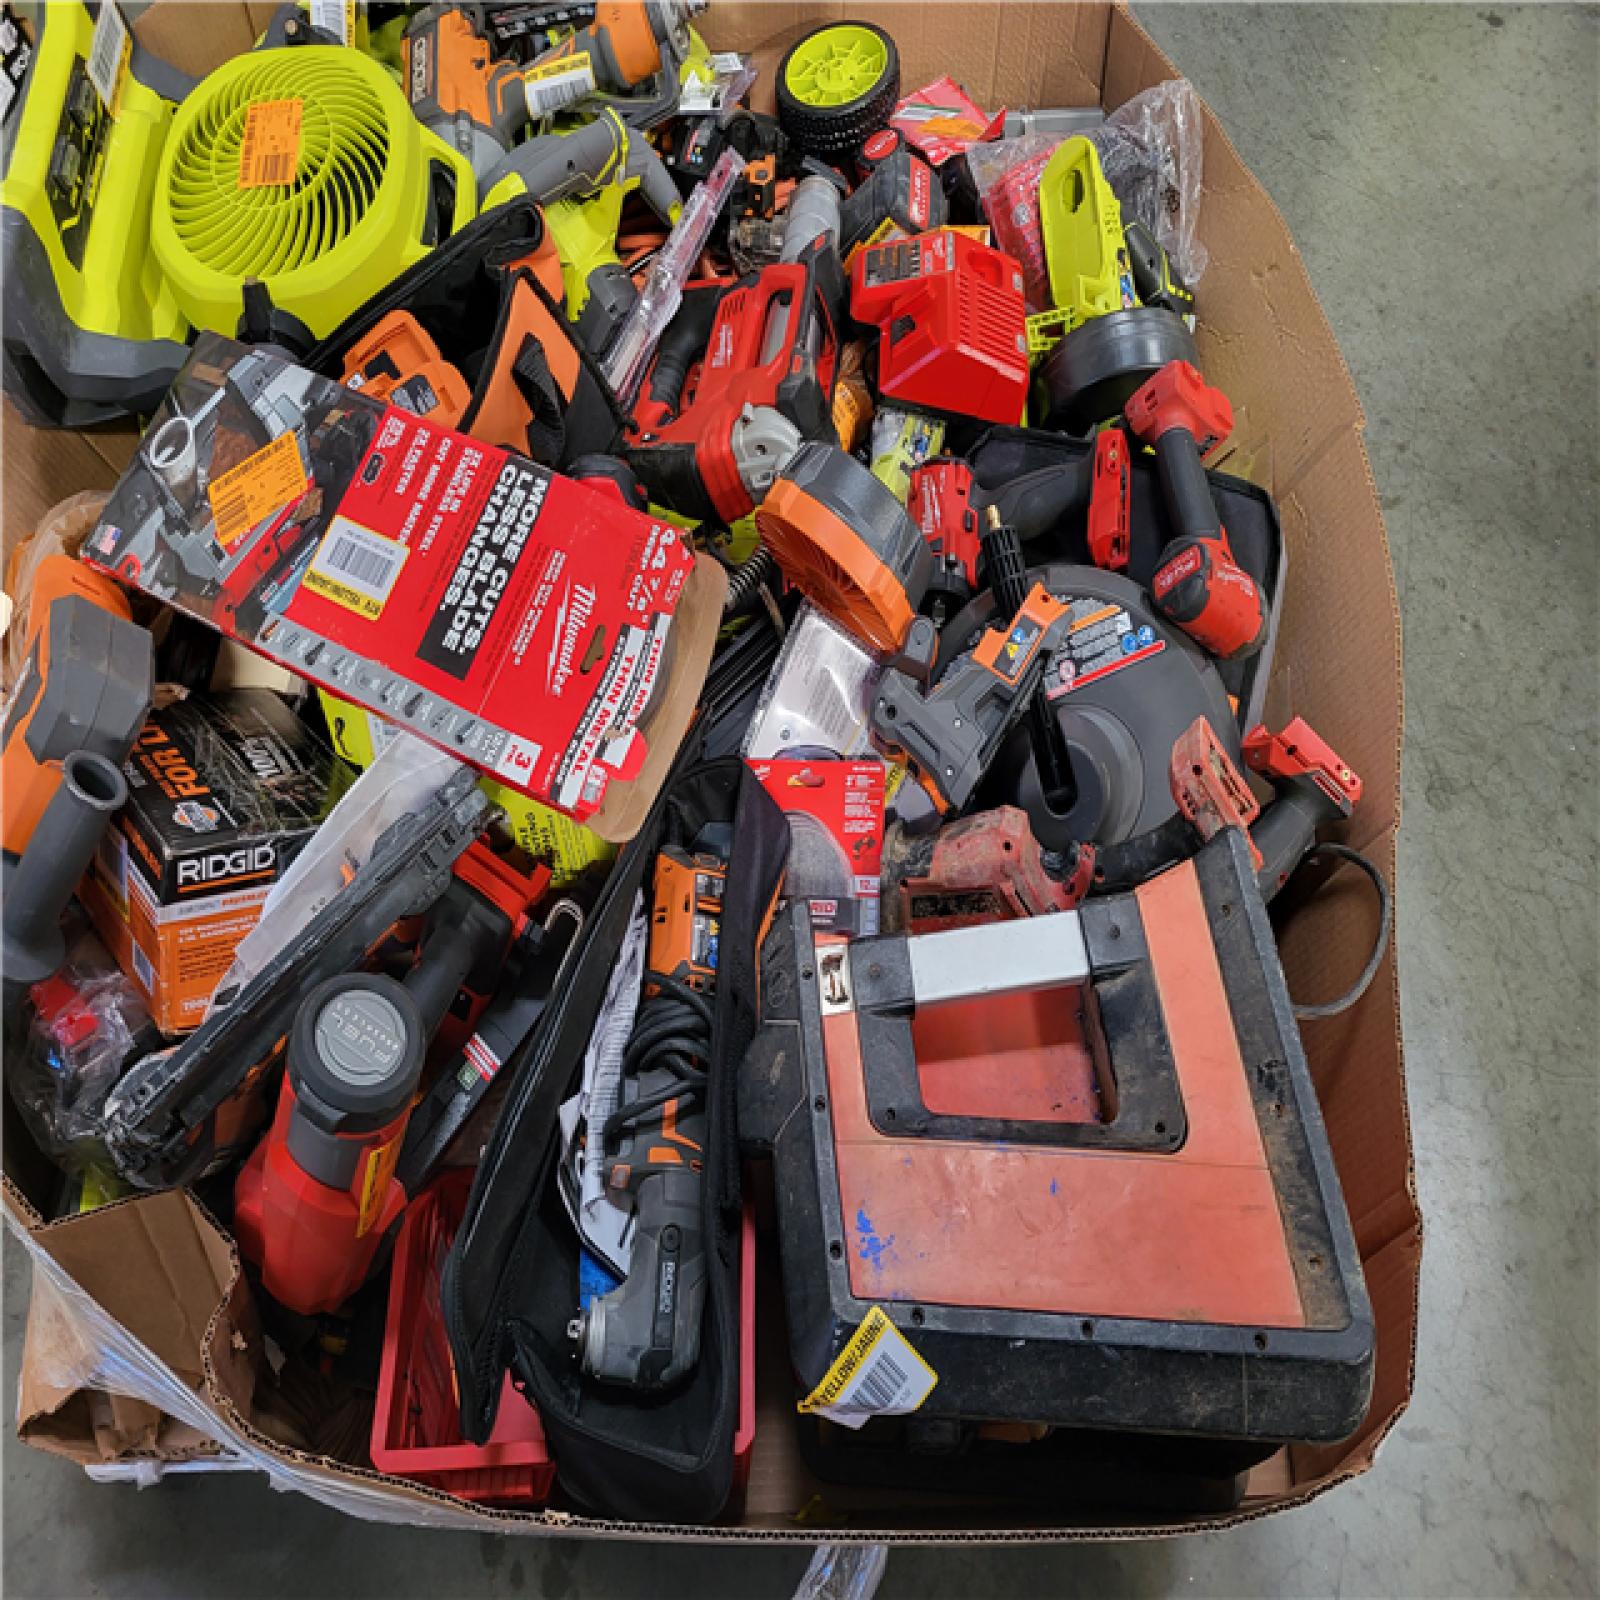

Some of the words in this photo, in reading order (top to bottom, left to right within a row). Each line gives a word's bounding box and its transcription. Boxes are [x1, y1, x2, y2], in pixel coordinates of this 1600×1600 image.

[439, 464, 517, 611] CHANGES.
[490, 470, 533, 546] LESS
[501, 477, 549, 563] MORE
[441, 551, 499, 651] BLADE
[457, 567, 509, 655] CUTS.
[552, 583, 597, 696] Milwaukee
[609, 653, 635, 704] THIN
[151, 749, 211, 798] FOR
[514, 750, 533, 770] 3
[571, 706, 611, 777] METAL
[177, 846, 276, 885] RIDGID
[331, 1011, 392, 1064] FUEL
